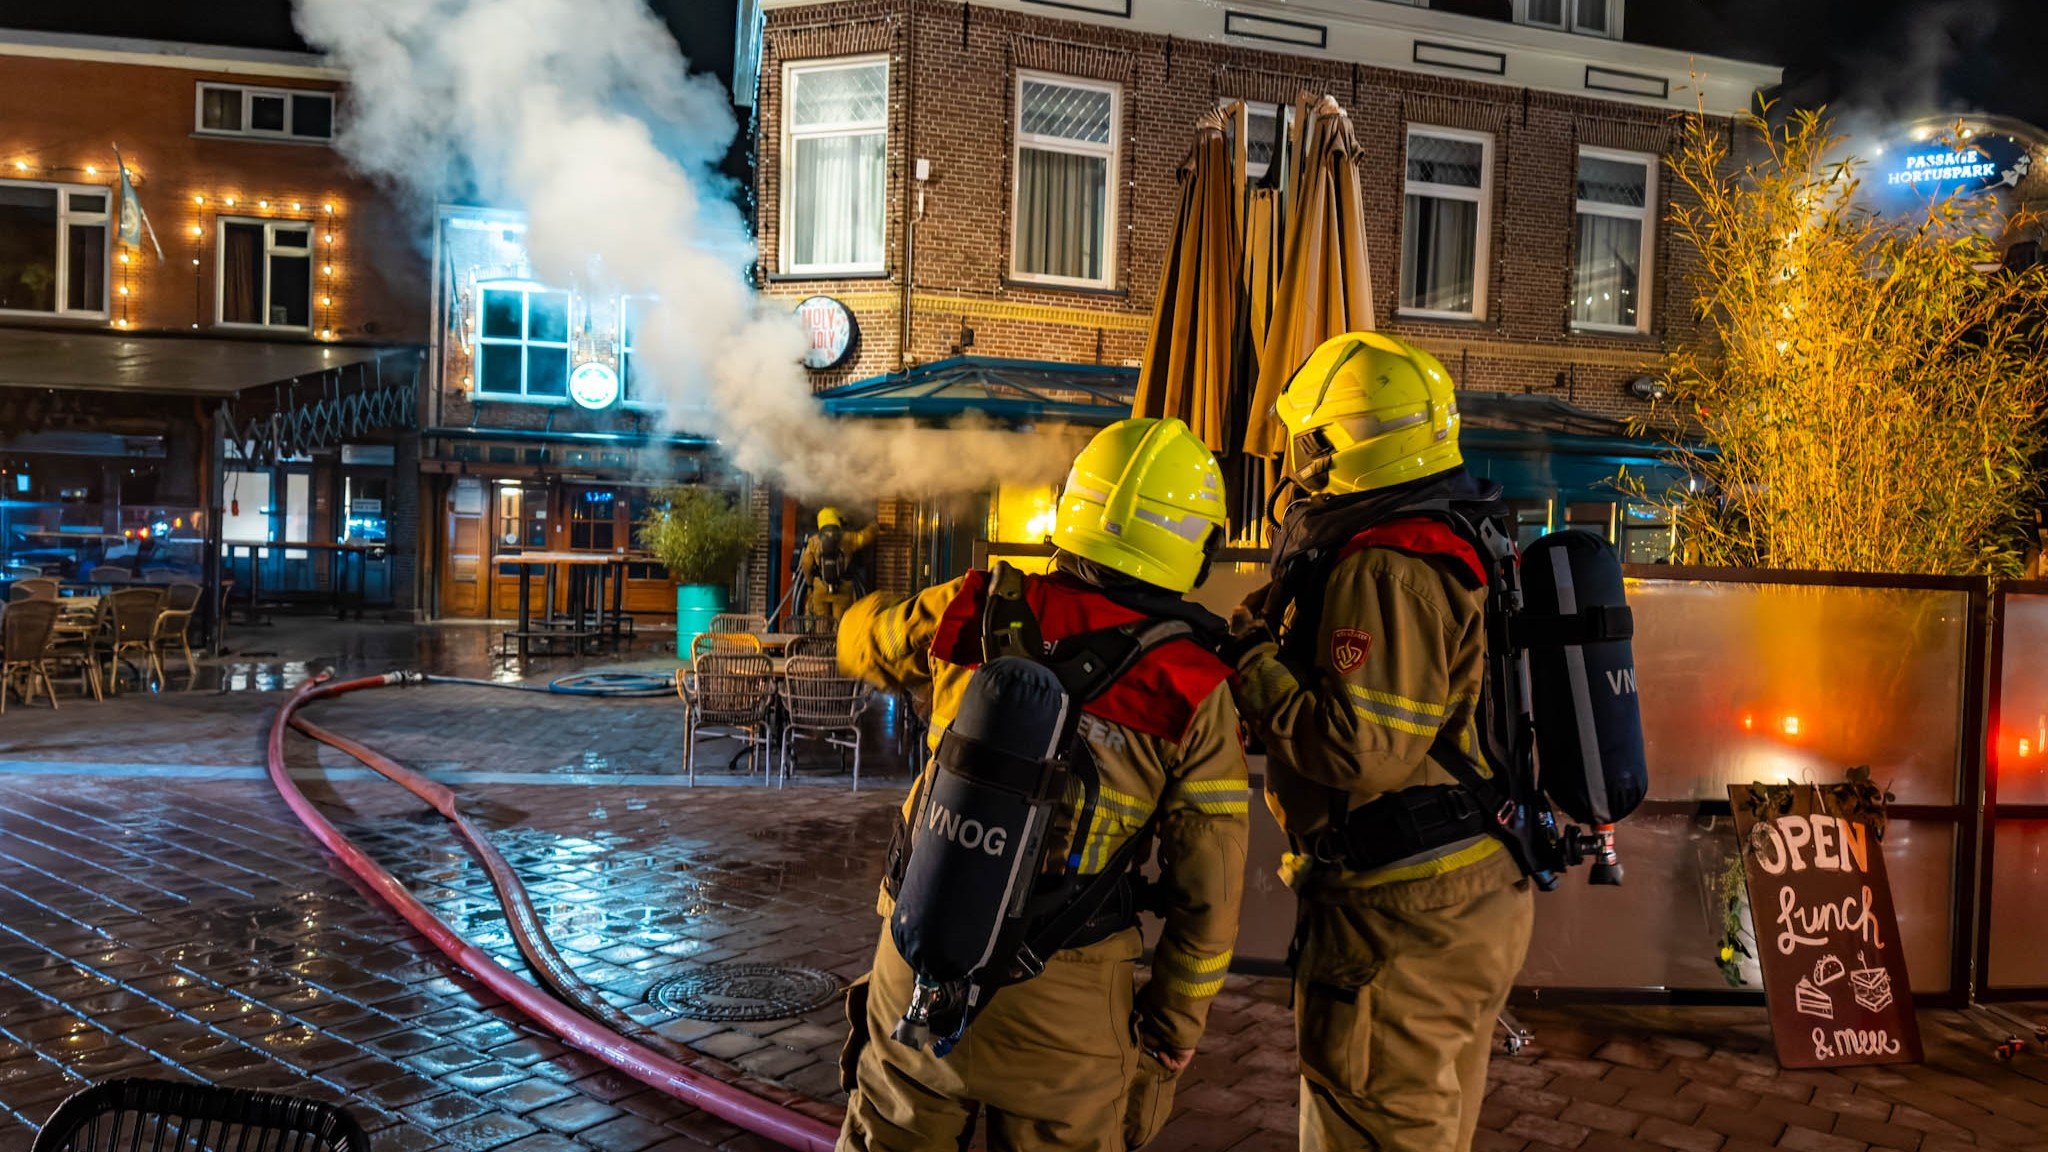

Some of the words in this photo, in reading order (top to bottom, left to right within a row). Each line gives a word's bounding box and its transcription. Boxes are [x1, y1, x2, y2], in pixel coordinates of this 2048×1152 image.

[1888, 163, 1995, 185] HORTUSPARK
[1906, 151, 1977, 169] PASSAGE
[1606, 667, 1638, 696] VN
[929, 801, 1008, 856] VNOG
[1751, 813, 1868, 875] OPEN
[1777, 885, 1885, 955] Lunch
[1811, 1027, 1834, 1060] &
